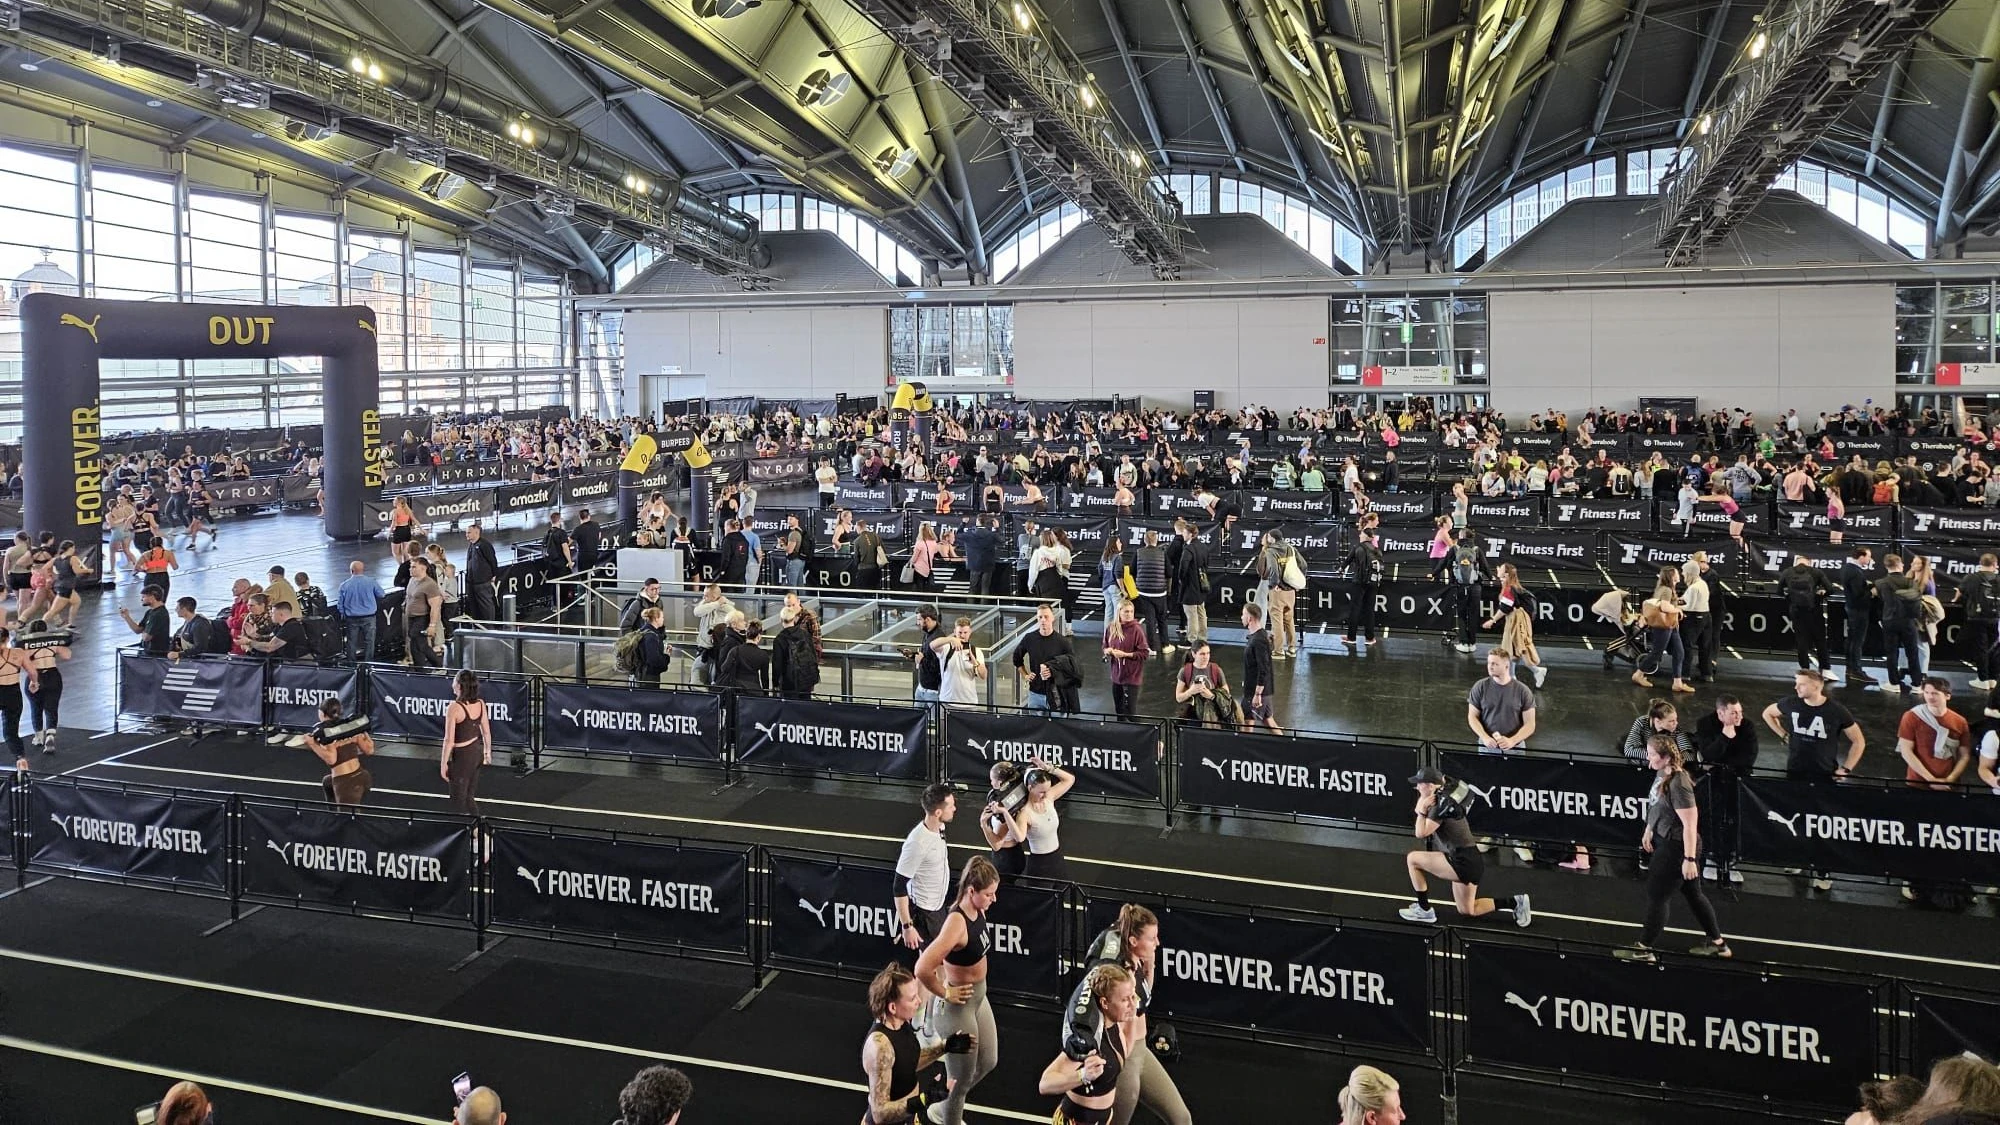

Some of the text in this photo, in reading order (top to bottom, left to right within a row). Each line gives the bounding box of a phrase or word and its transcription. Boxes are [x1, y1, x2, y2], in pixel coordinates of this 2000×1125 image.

[208, 316, 275, 346] OUT
[661, 437, 690, 449] BURPEES
[1653, 439, 1684, 448] Therabody
[1847, 442, 1881, 450] Therabody
[1921, 442, 1955, 451] Therabody
[711, 448, 736, 458] ROX
[71, 398, 101, 526] FOREVER.
[752, 463, 805, 475] HYROX
[442, 466, 497, 480] HYROX
[215, 485, 272, 499] YROX
[510, 489, 549, 507] amazfit
[572, 481, 609, 498] amazfit
[426, 498, 480, 517] amazfit
[1270, 499, 1324, 511] Fitness First
[1368, 501, 1424, 513] Fitness First
[1471, 504, 1530, 517] Fitness First
[1579, 508, 1641, 520] Fitness First
[1855, 515, 1881, 527] First
[875, 523, 896, 534] First
[1939, 517, 2000, 532] Fitness Firs
[1079, 529, 1102, 541] First
[1304, 535, 1328, 548] First
[1383, 538, 1424, 551] Fitness
[1510, 541, 1584, 557] Fitness First
[491, 569, 549, 598] YROX
[1318, 591, 1444, 616] HROX
[405, 696, 456, 717] FOREVE
[583, 709, 702, 736] FOREVER. FASTER.
[1791, 711, 1828, 739] LA
[778, 723, 908, 754] FOREVER. FASTER.
[994, 740, 1137, 773] FOREVER. FASTER.
[1231, 760, 1393, 797] FOREVER. FASTER.
[1500, 786, 1650, 820] FOREVER. FAST
[73, 816, 207, 855] FOREVER. FASTER.
[1805, 813, 1912, 846] FOREVER.
[293, 843, 448, 883] FOREVER. FASTER.
[548, 869, 719, 914] FOREVER. FASTER.
[834, 903, 900, 937] FOREV
[1162, 948, 1394, 1006] FOREVER. FASTER.
[1555, 997, 1830, 1064] FOREVER. FASTER.
